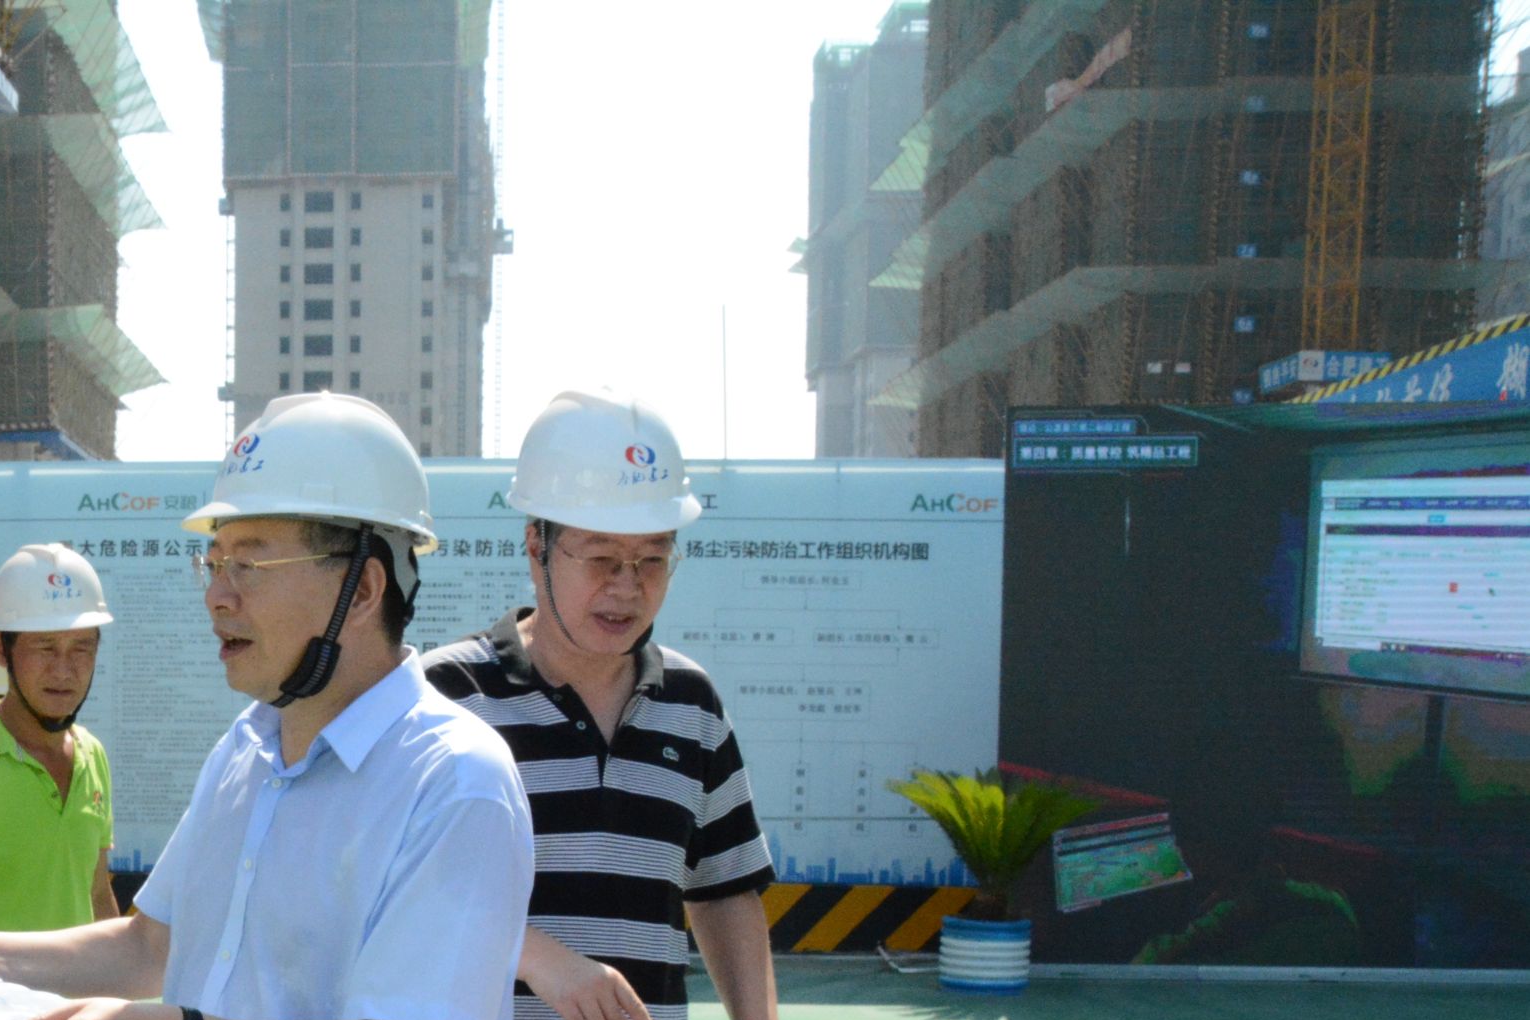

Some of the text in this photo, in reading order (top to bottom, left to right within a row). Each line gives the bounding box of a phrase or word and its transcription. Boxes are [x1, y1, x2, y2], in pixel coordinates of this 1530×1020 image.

[62, 539, 214, 557] 大危险源公示
[685, 540, 930, 561] 扬尘污染防治工作组织机构图
